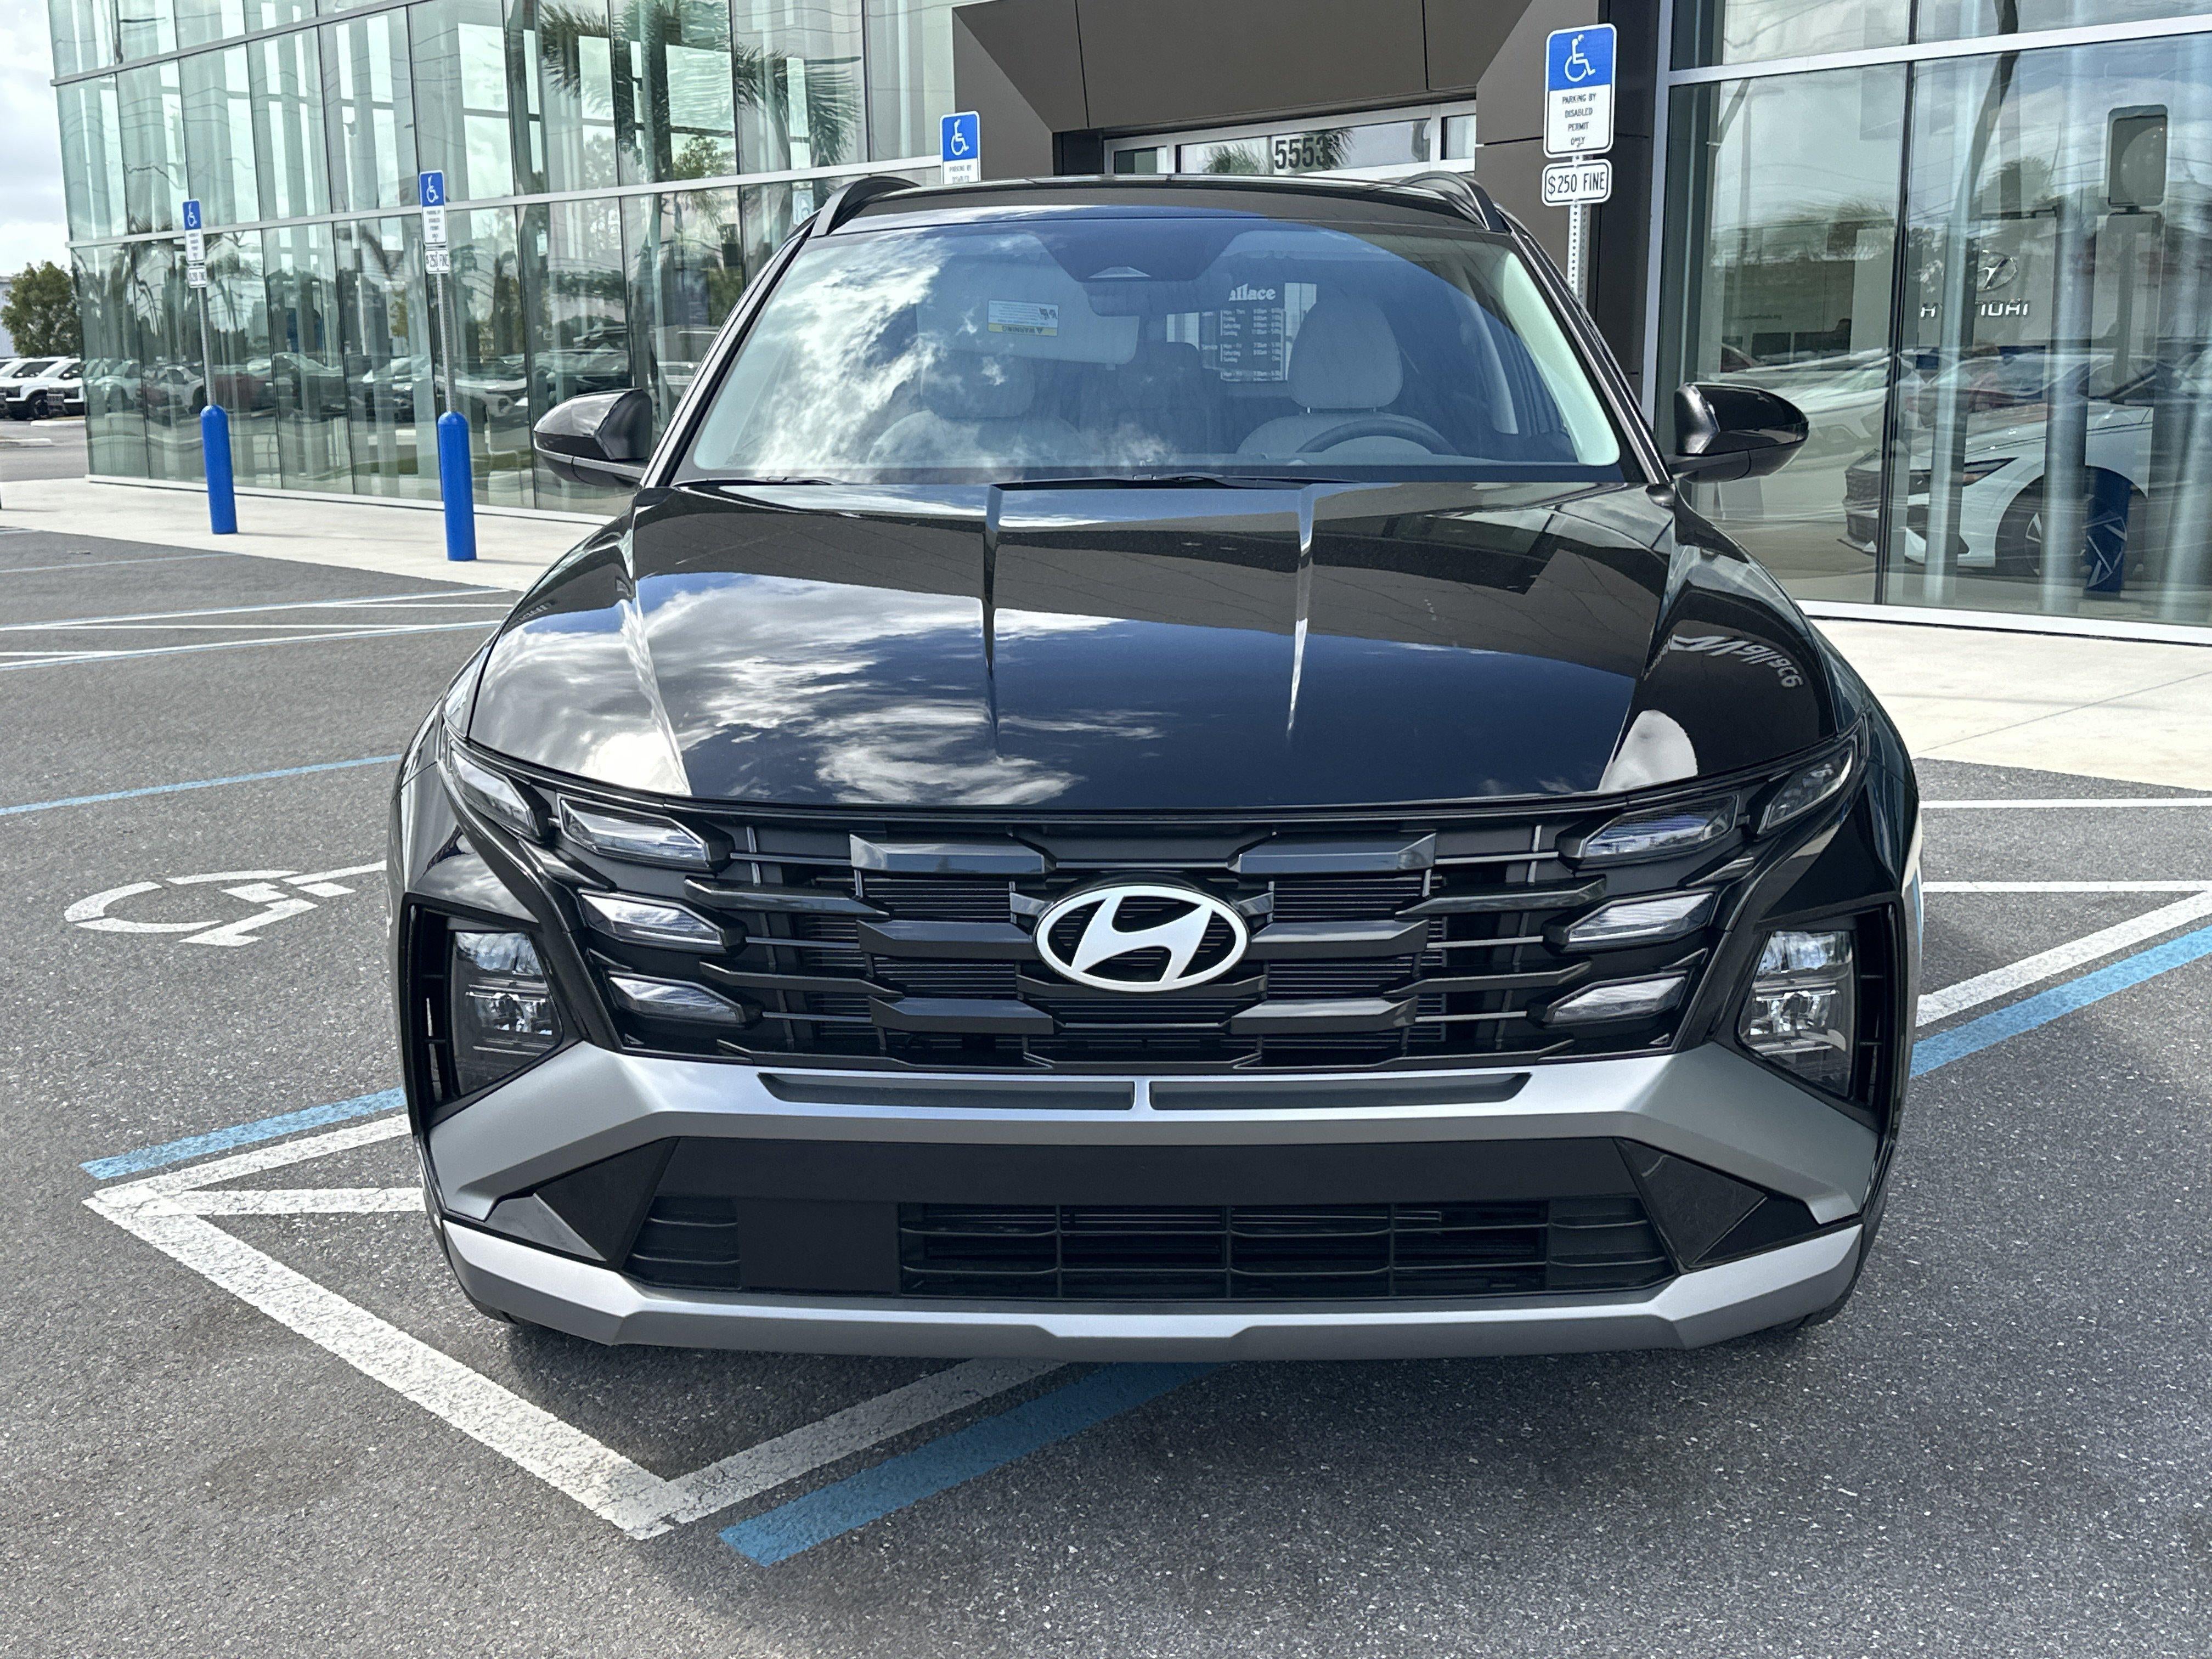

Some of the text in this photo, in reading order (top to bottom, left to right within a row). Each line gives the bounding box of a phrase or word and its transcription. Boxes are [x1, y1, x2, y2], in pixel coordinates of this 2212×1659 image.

[1562, 92, 1596, 104] PARKING BY
[1565, 108, 1593, 118] DISABLED
[1568, 122, 1589, 132] PERMIT
[1274, 136, 1324, 169] 5553
[1548, 172, 1605, 196] $250 FINE
